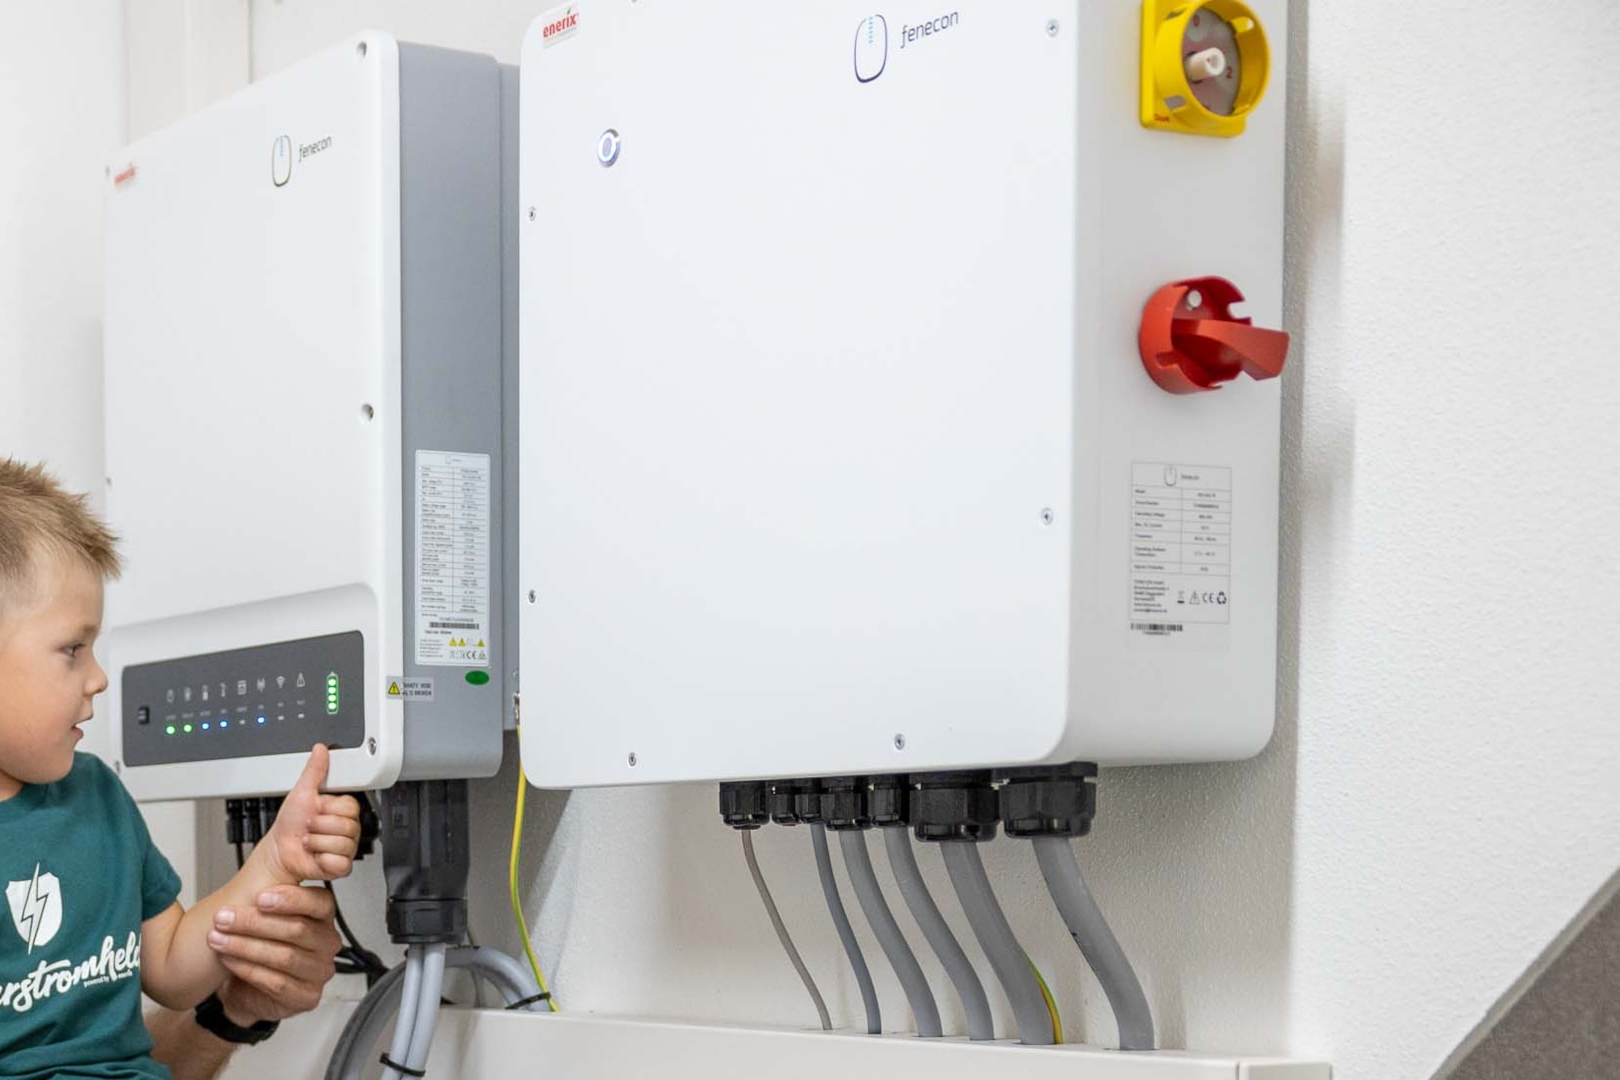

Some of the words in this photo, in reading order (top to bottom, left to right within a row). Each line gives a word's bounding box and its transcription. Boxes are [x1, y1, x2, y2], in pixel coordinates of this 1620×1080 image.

[543, 9, 576, 38] enerix
[900, 11, 959, 49] fenecon
[298, 136, 333, 164] fenecon
